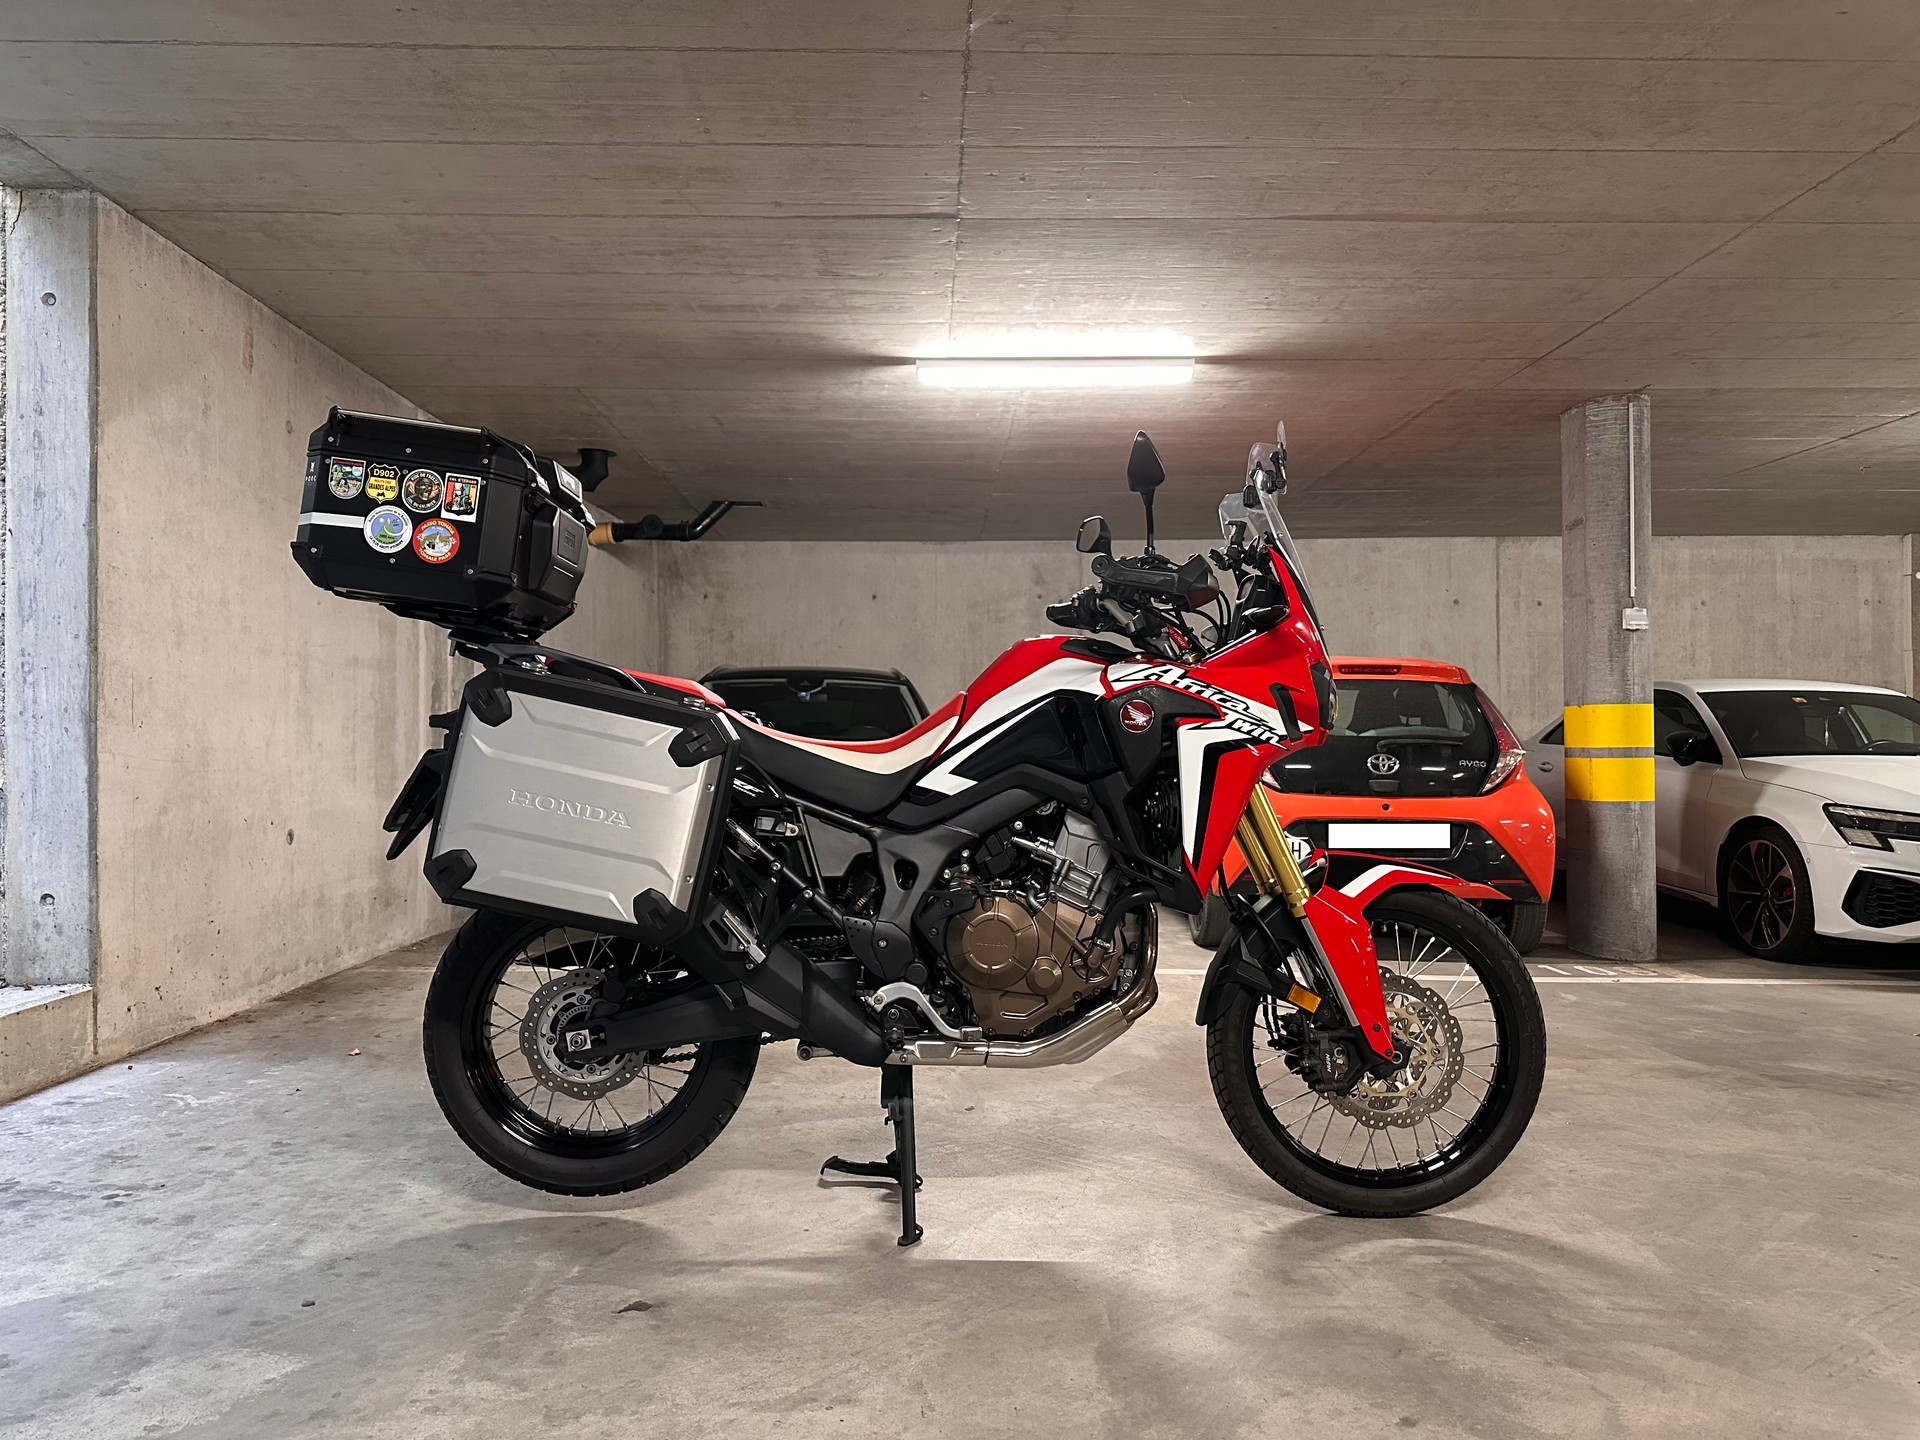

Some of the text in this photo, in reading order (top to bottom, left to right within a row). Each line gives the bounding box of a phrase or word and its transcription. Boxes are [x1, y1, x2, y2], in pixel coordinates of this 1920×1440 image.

[373, 468, 395, 478] D902
[369, 483, 385, 491] GRANDES
[421, 520, 437, 530] PASSO
[438, 520, 455, 534] TONALE
[418, 548, 452, 561] TONALE PASS
[1113, 664, 1264, 720] Africa
[1124, 719, 1148, 727] HONDA
[1188, 709, 1287, 750] Twin
[1459, 760, 1487, 768] AYGO
[508, 788, 632, 829] HONDA
